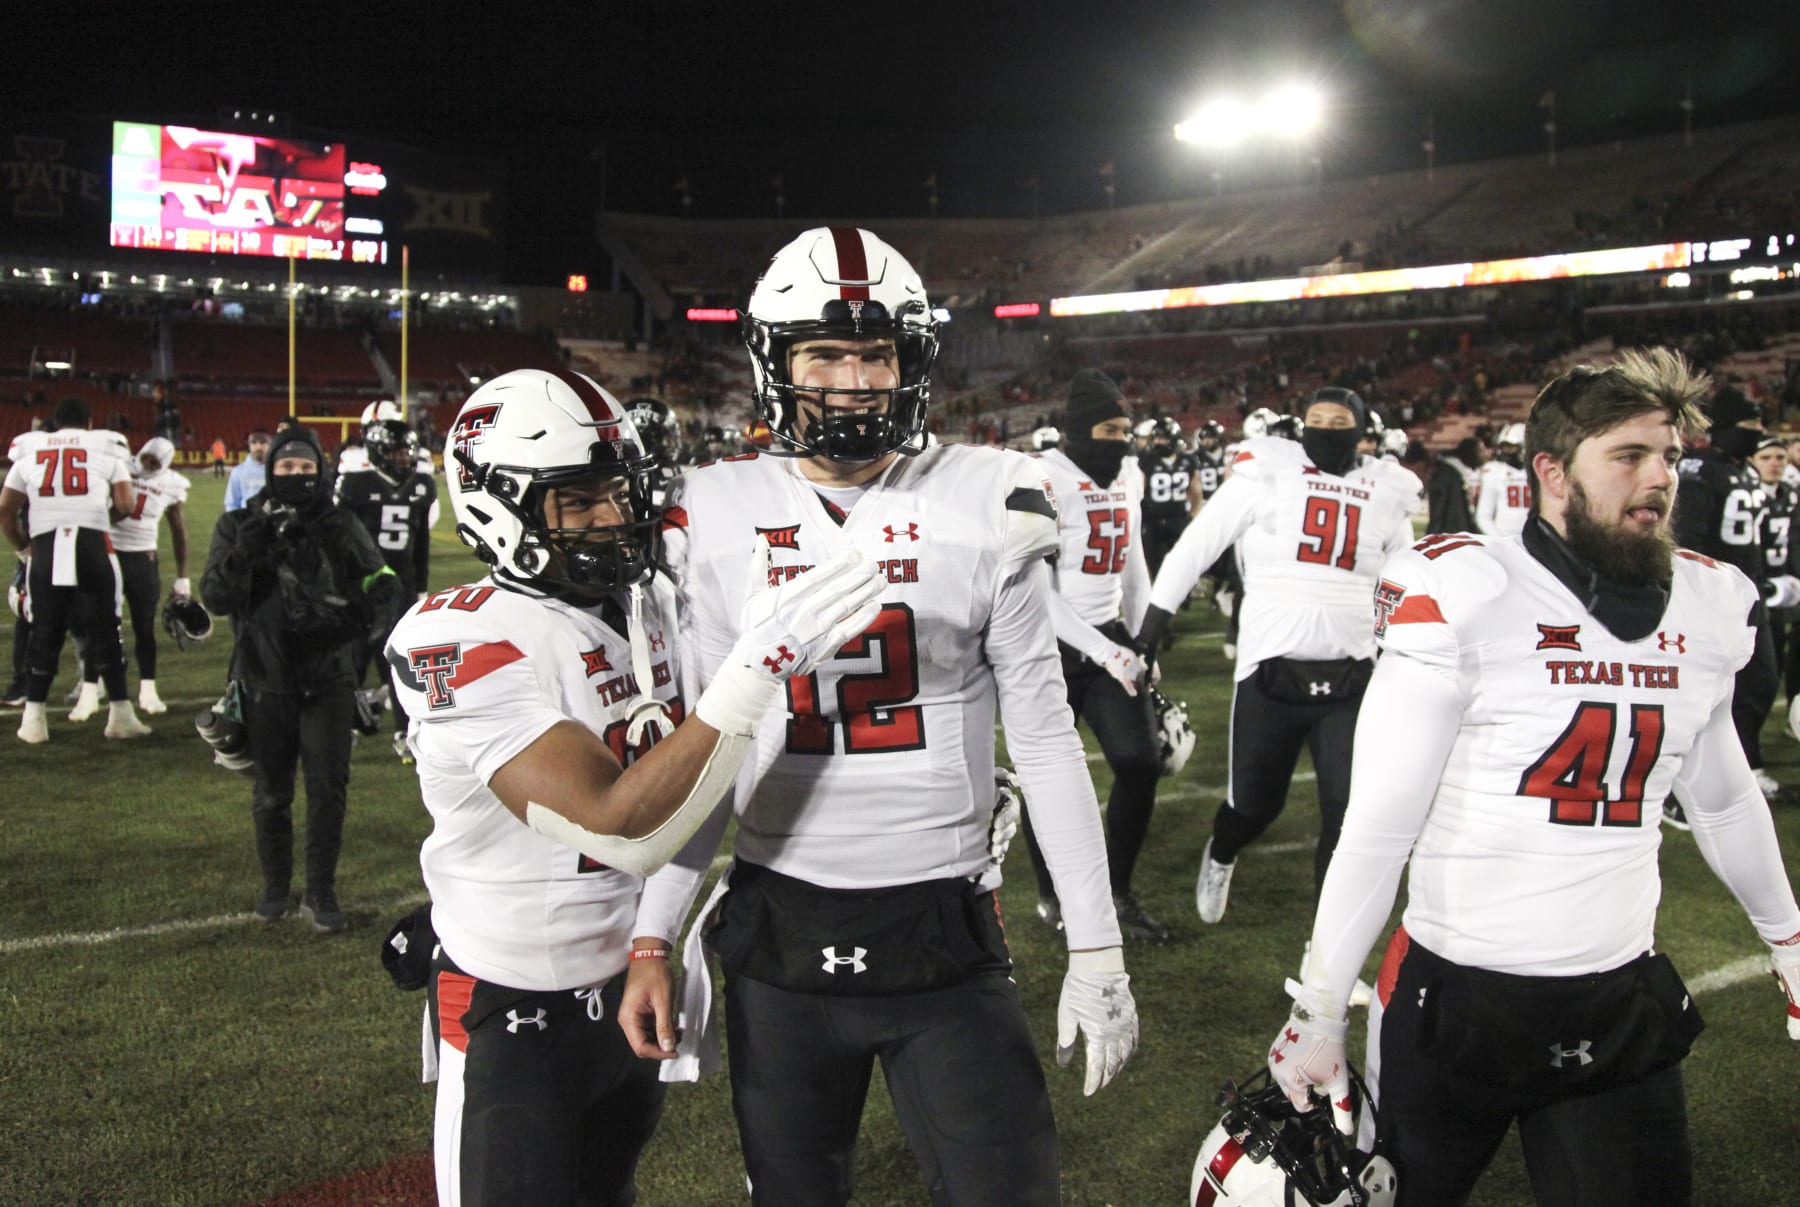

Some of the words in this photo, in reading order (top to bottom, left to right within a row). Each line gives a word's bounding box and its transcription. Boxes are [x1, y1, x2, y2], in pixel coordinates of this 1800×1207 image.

[0, 160, 102, 202] TATE
[568, 274, 587, 291] 25
[36, 448, 89, 497] 76
[1150, 472, 1190, 502] 82
[1308, 480, 1342, 493] TEXAS
[1345, 486, 1371, 500] TECH
[378, 505, 410, 550] 5
[1081, 507, 1130, 575] 52
[1296, 496, 1362, 572] 91
[1766, 517, 1791, 566] 3
[876, 558, 919, 584] CH
[595, 672, 642, 708] TEXA
[786, 601, 927, 755] 12
[1546, 661, 1623, 686] TEXAS
[1629, 664, 1679, 689] TECH
[1516, 701, 1665, 827] 41
